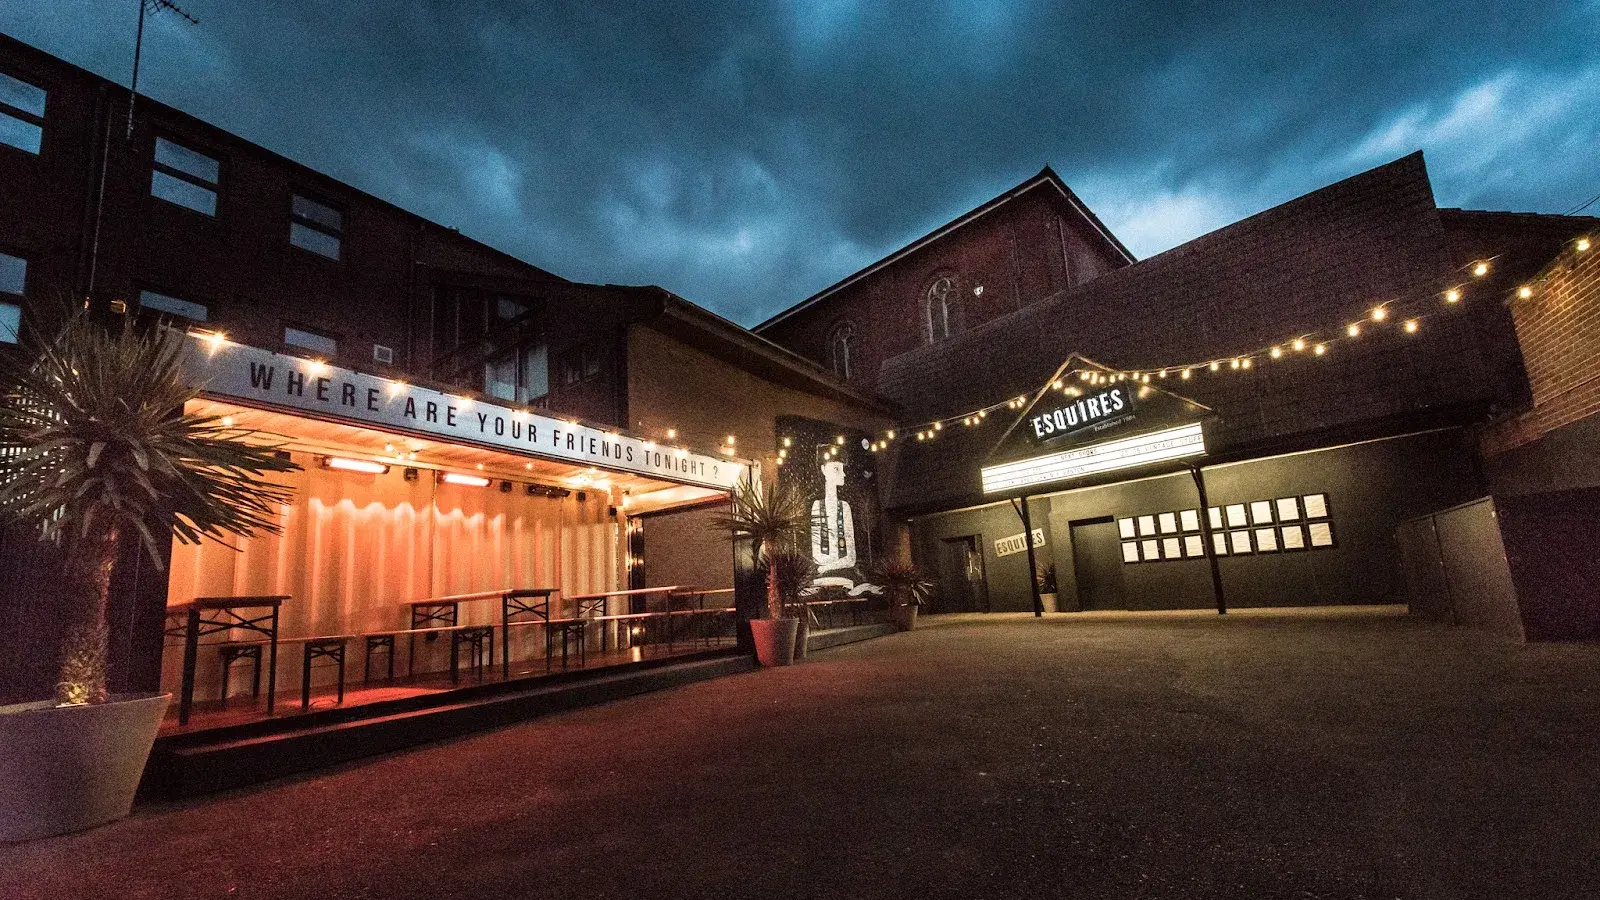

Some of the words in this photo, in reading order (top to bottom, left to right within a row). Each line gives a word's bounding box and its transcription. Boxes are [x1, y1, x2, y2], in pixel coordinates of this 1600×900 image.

[250, 361, 381, 412] WHERE
[404, 397, 457, 427] ARE
[477, 412, 537, 443] YOUR
[553, 428, 634, 462] FRIENDS
[644, 449, 706, 476] TONIGHT
[711, 465, 719, 479] ?
[1033, 388, 1124, 438] ESQUIRES
[996, 532, 1043, 554] ESQUIES
